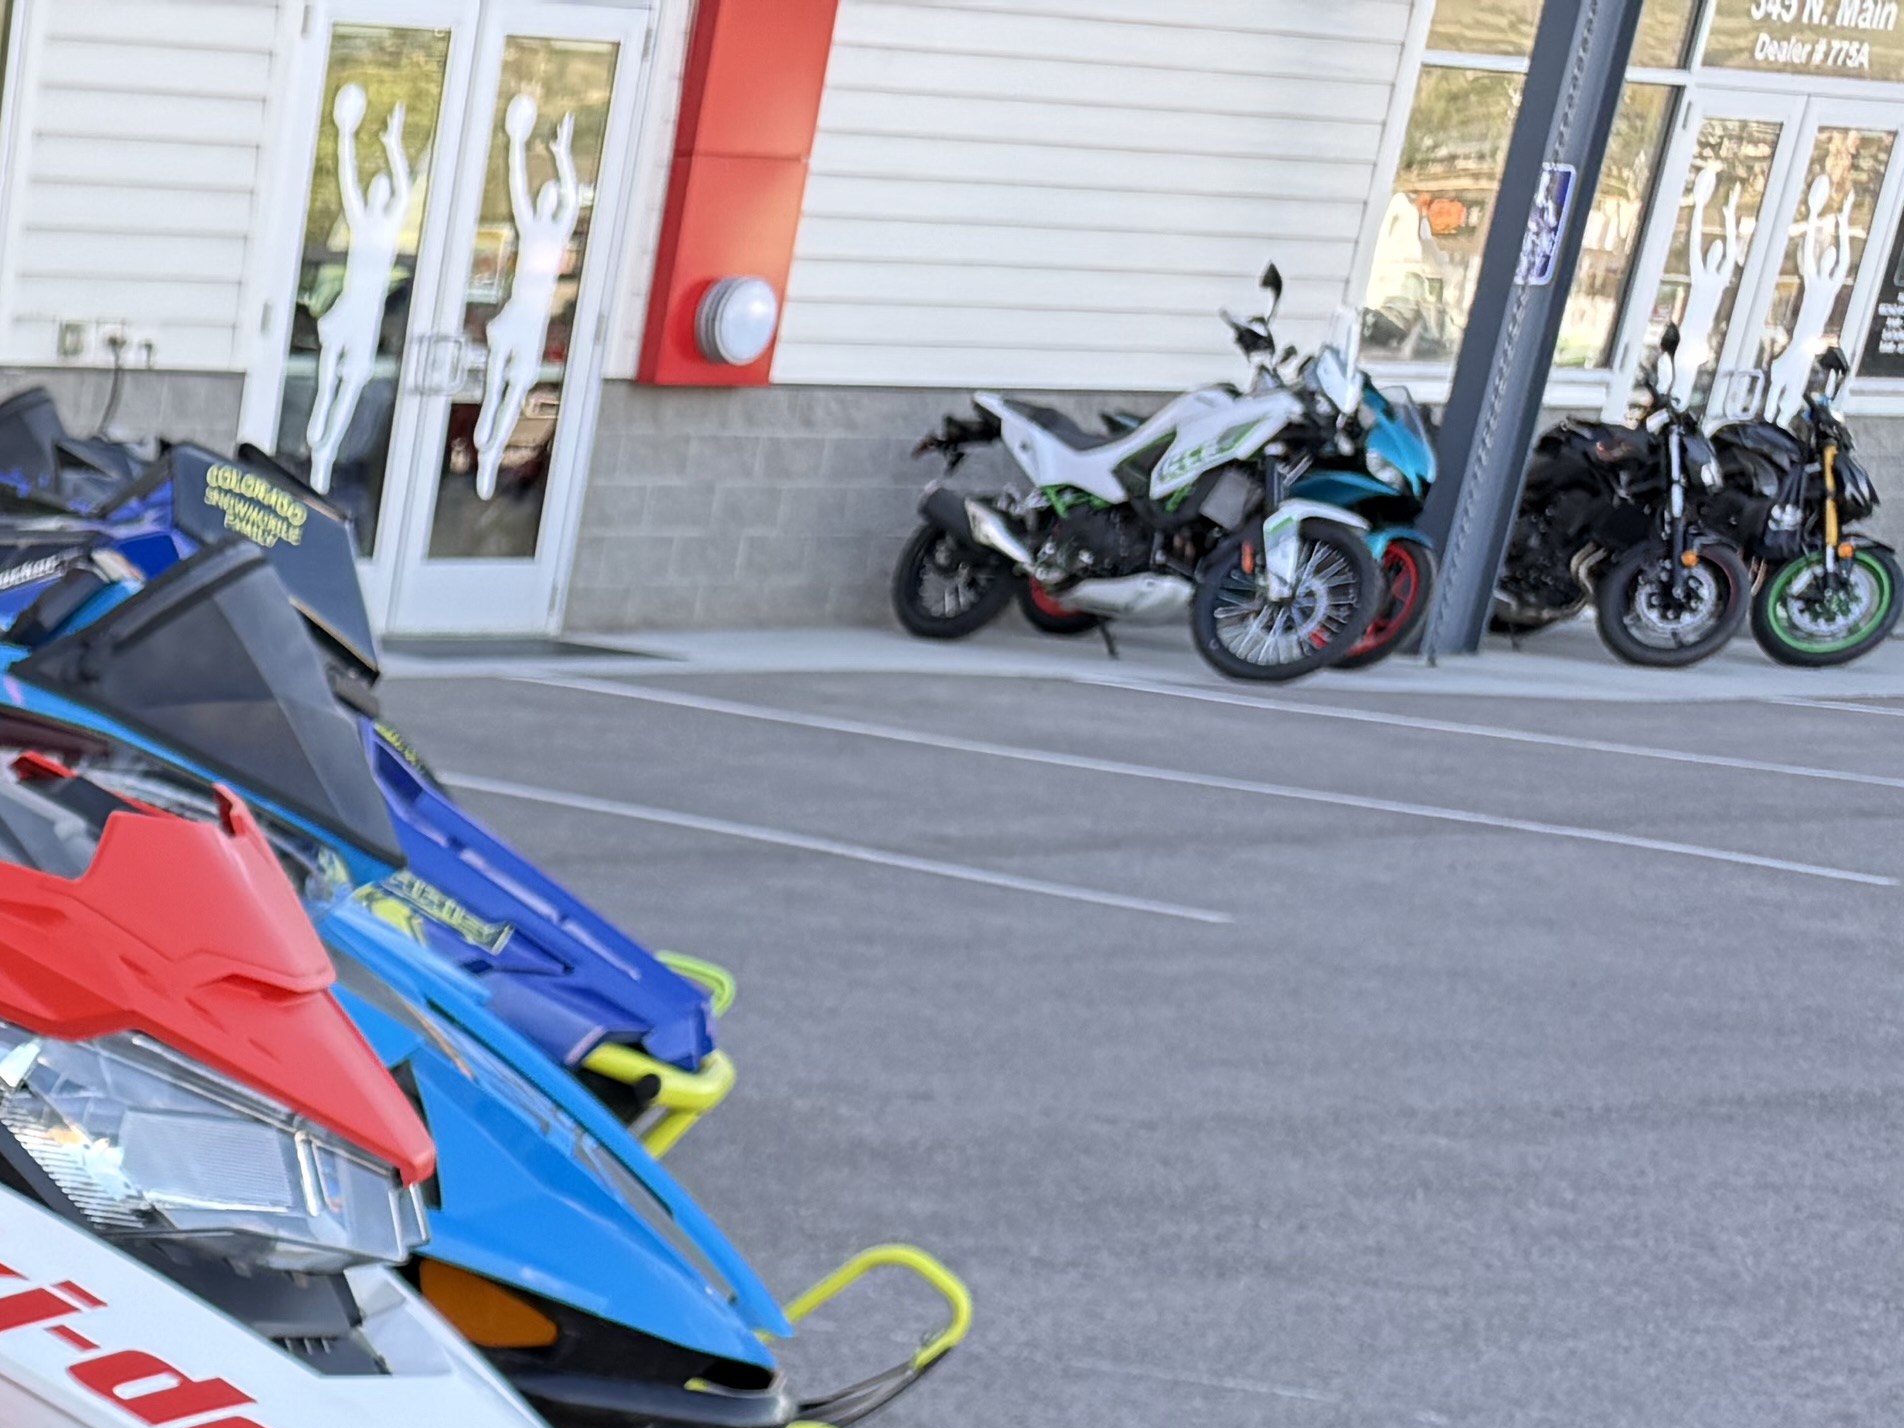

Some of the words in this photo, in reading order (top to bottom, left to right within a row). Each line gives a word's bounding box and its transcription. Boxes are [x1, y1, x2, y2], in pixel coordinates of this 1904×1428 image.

[1835, 0, 1899, 31] Main
[1754, 32, 1812, 65] Dealer
[1812, 37, 1827, 65] #
[204, 486, 303, 546] SNOWMOBILE
[206, 463, 308, 527] COLORADO
